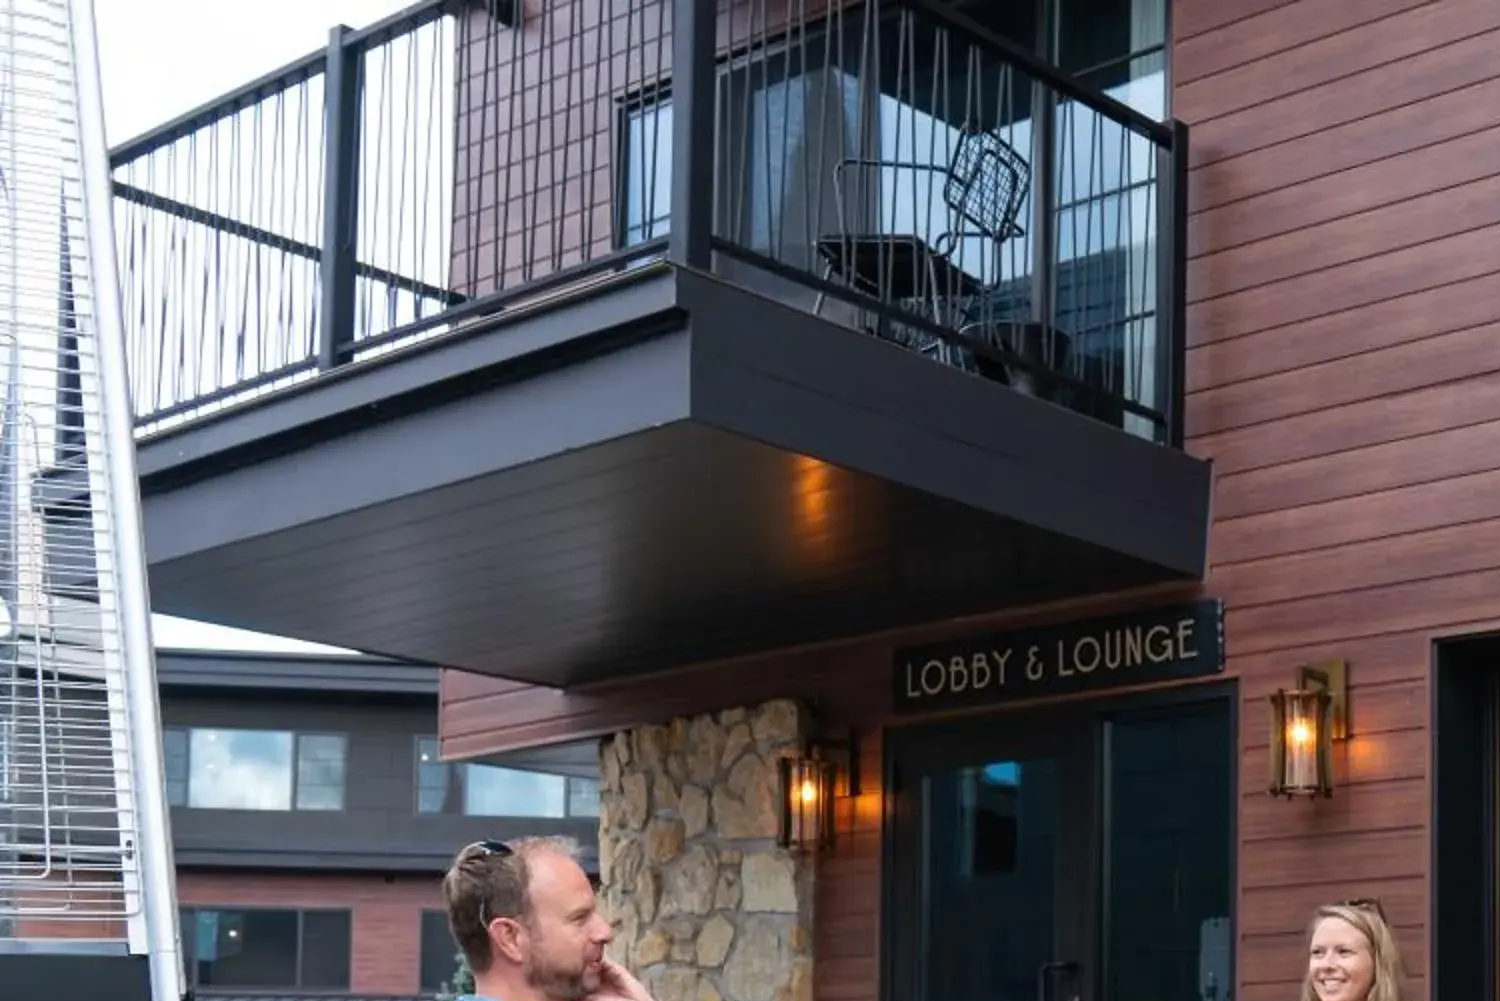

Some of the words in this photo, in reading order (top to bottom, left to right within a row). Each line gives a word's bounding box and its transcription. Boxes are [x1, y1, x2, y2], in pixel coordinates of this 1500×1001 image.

[906, 649, 1012, 697] LOBBY
[1026, 646, 1043, 681] &
[1058, 619, 1199, 676] LOUNGE
